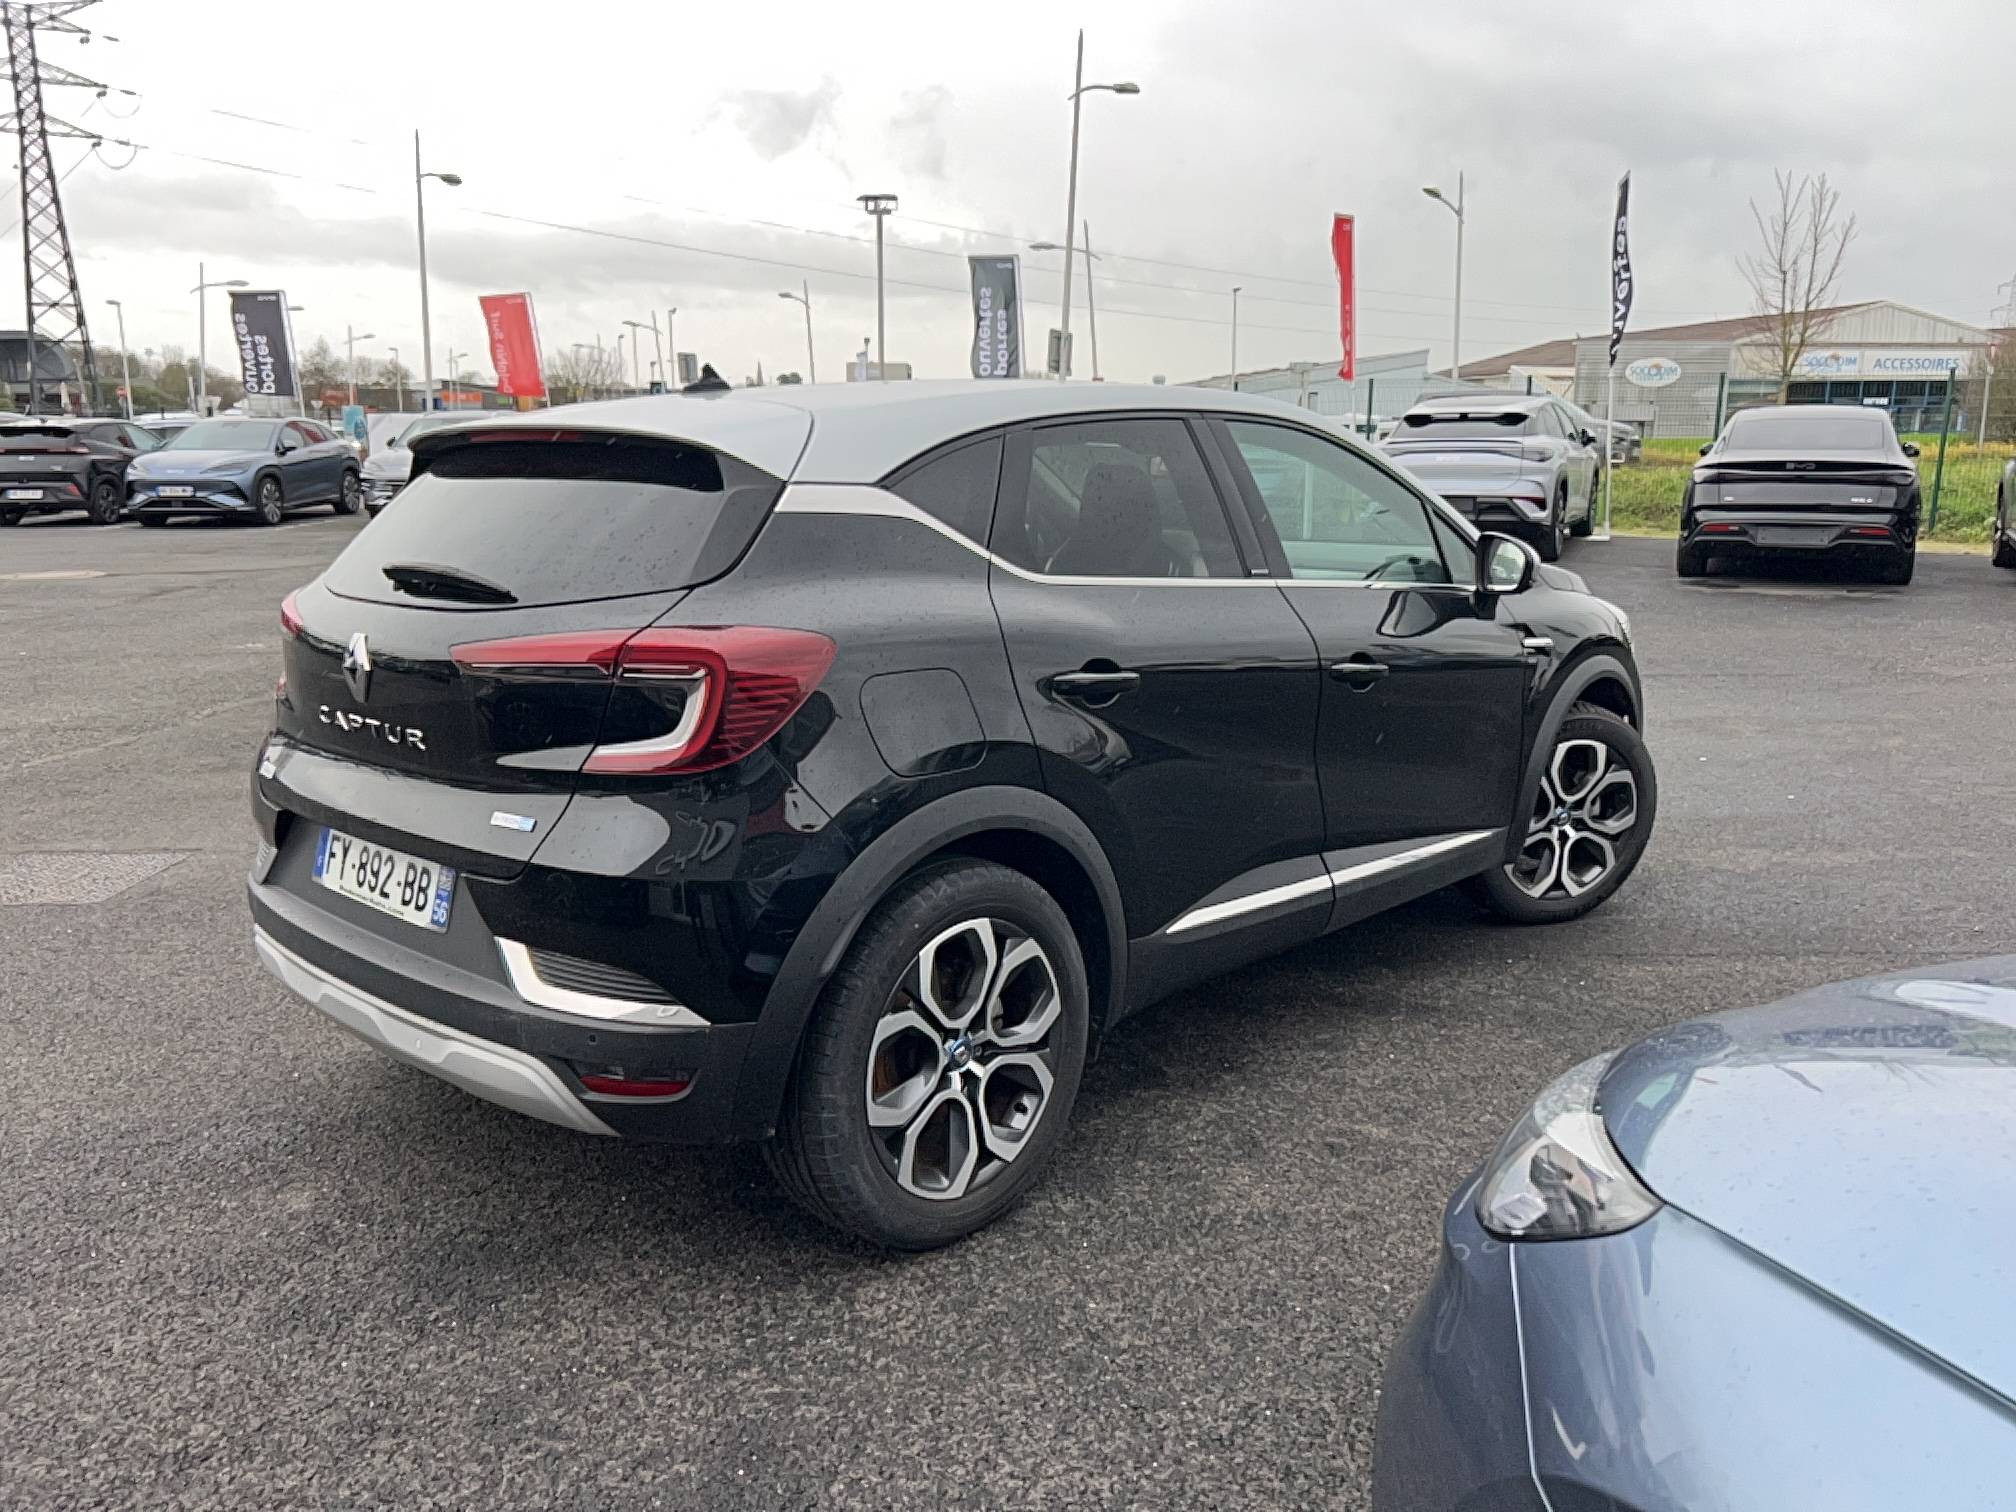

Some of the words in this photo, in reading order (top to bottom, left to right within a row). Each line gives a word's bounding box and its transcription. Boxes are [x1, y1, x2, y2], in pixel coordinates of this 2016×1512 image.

[1872, 357, 1960, 370] ACCESSOIRES
[318, 704, 427, 752] CAPTUR
[326, 834, 432, 912] FY-892-BB
[432, 899, 448, 925] 56
